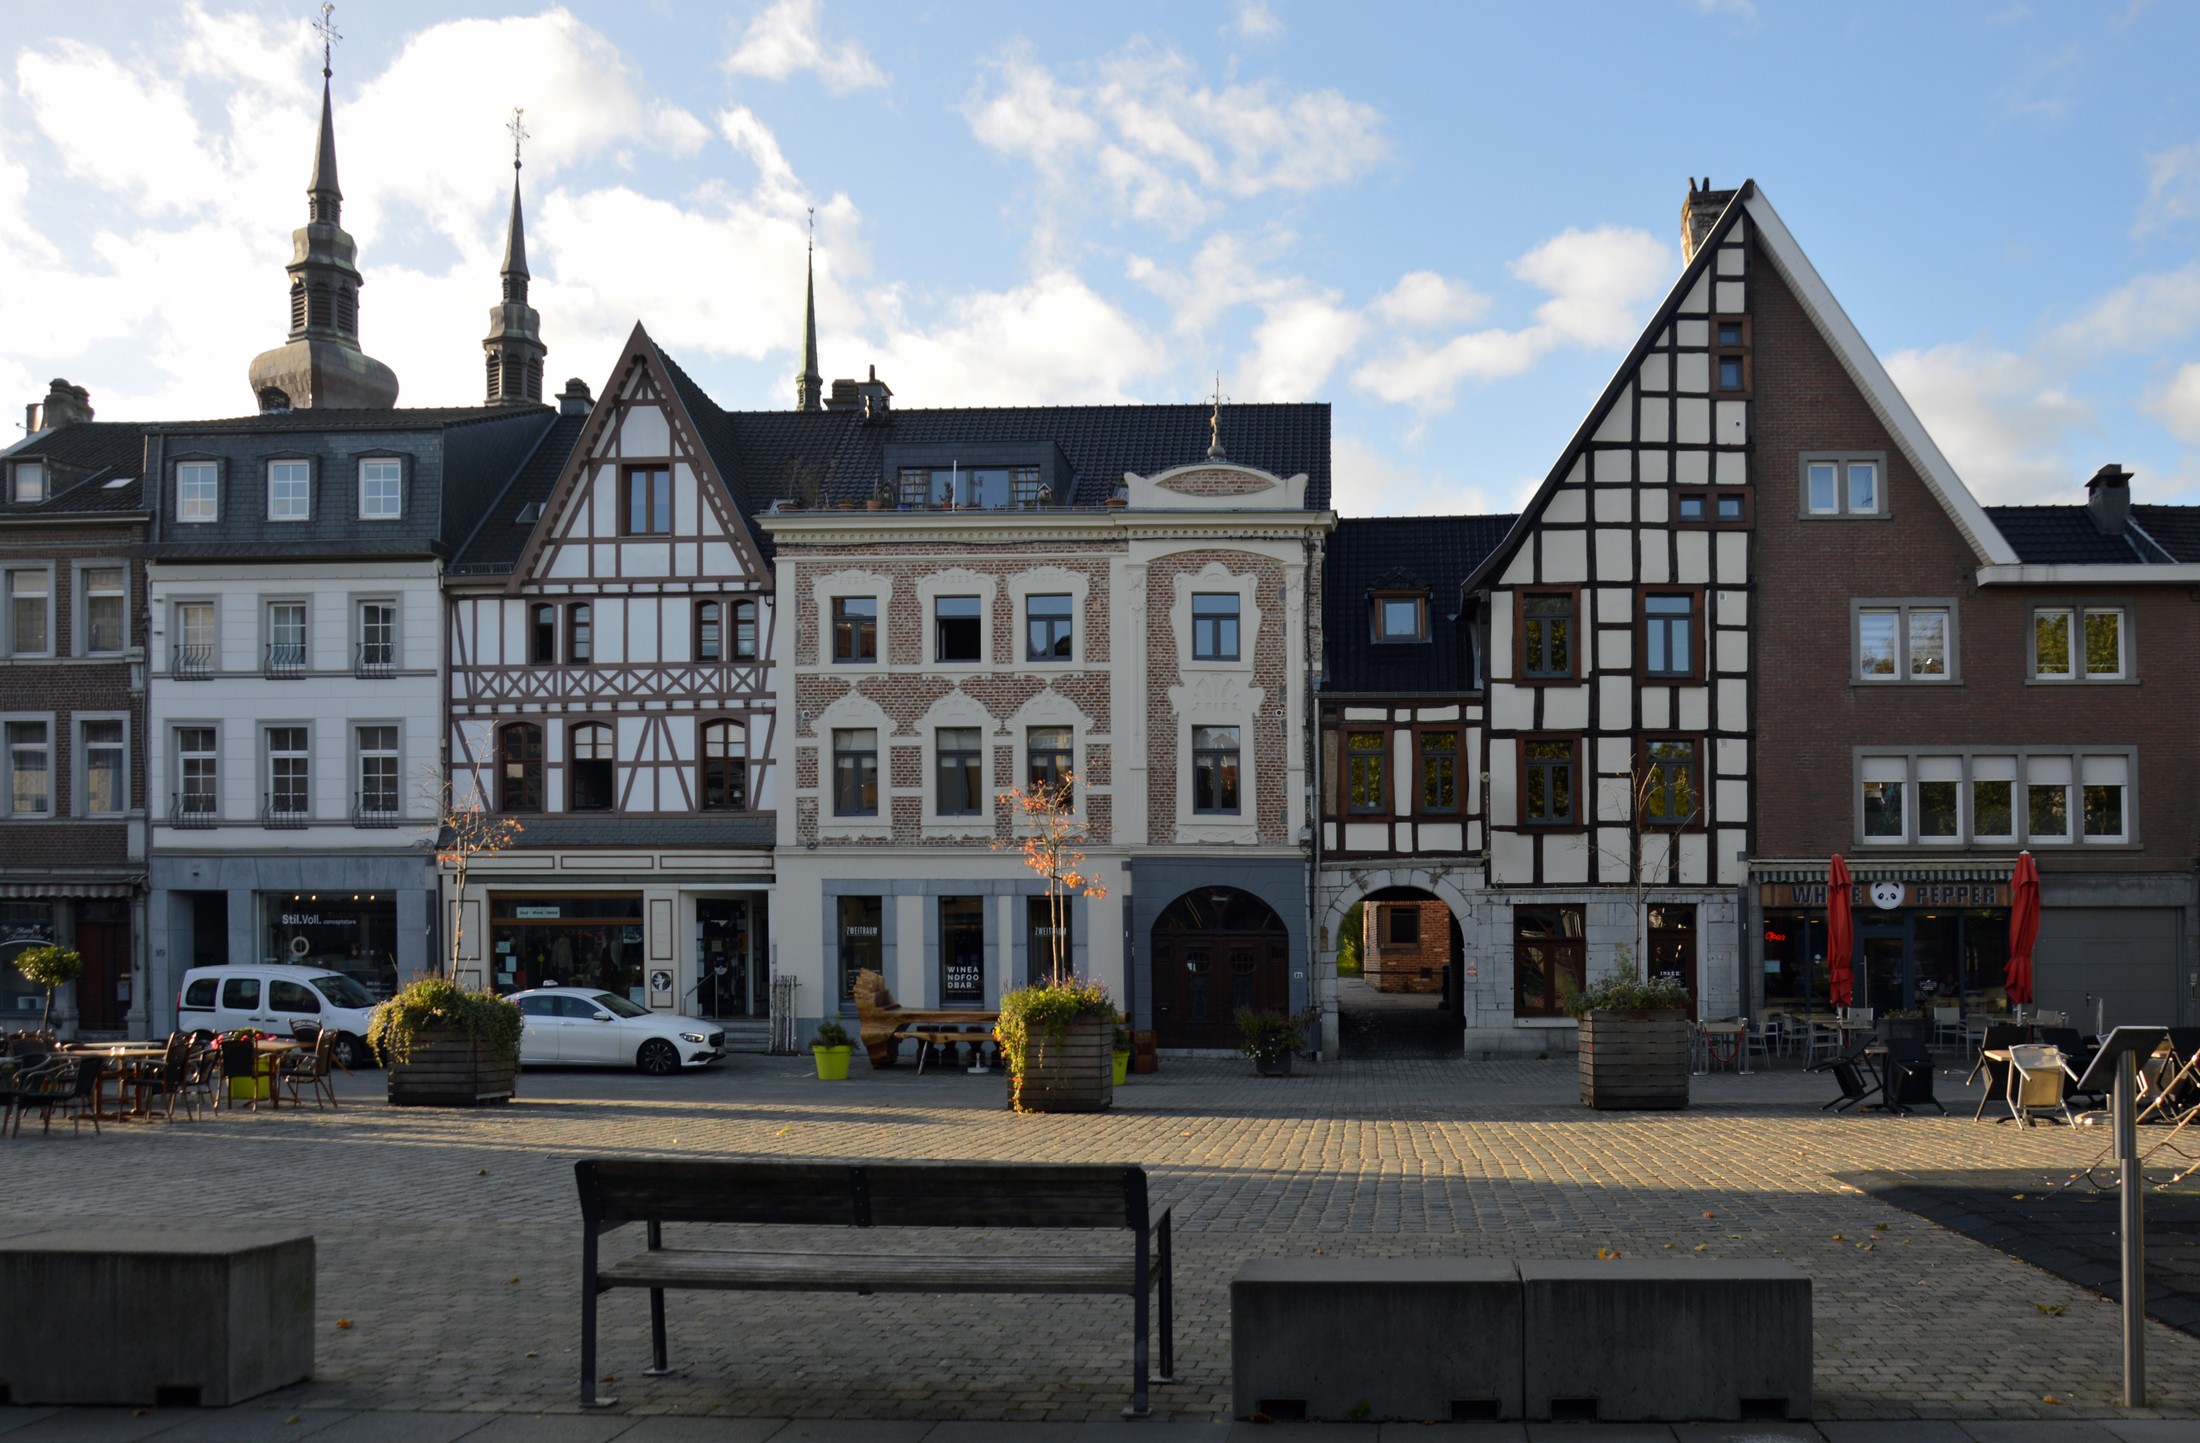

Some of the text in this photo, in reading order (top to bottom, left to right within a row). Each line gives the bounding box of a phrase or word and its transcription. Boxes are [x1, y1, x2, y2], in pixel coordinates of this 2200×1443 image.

[1792, 886, 1996, 904] WHE PEPPER
[282, 914, 322, 925] Stil.Voll.
[846, 926, 878, 935] ZWEITRAUM
[1765, 931, 1786, 942] Open
[947, 981, 976, 989] DBAR.
